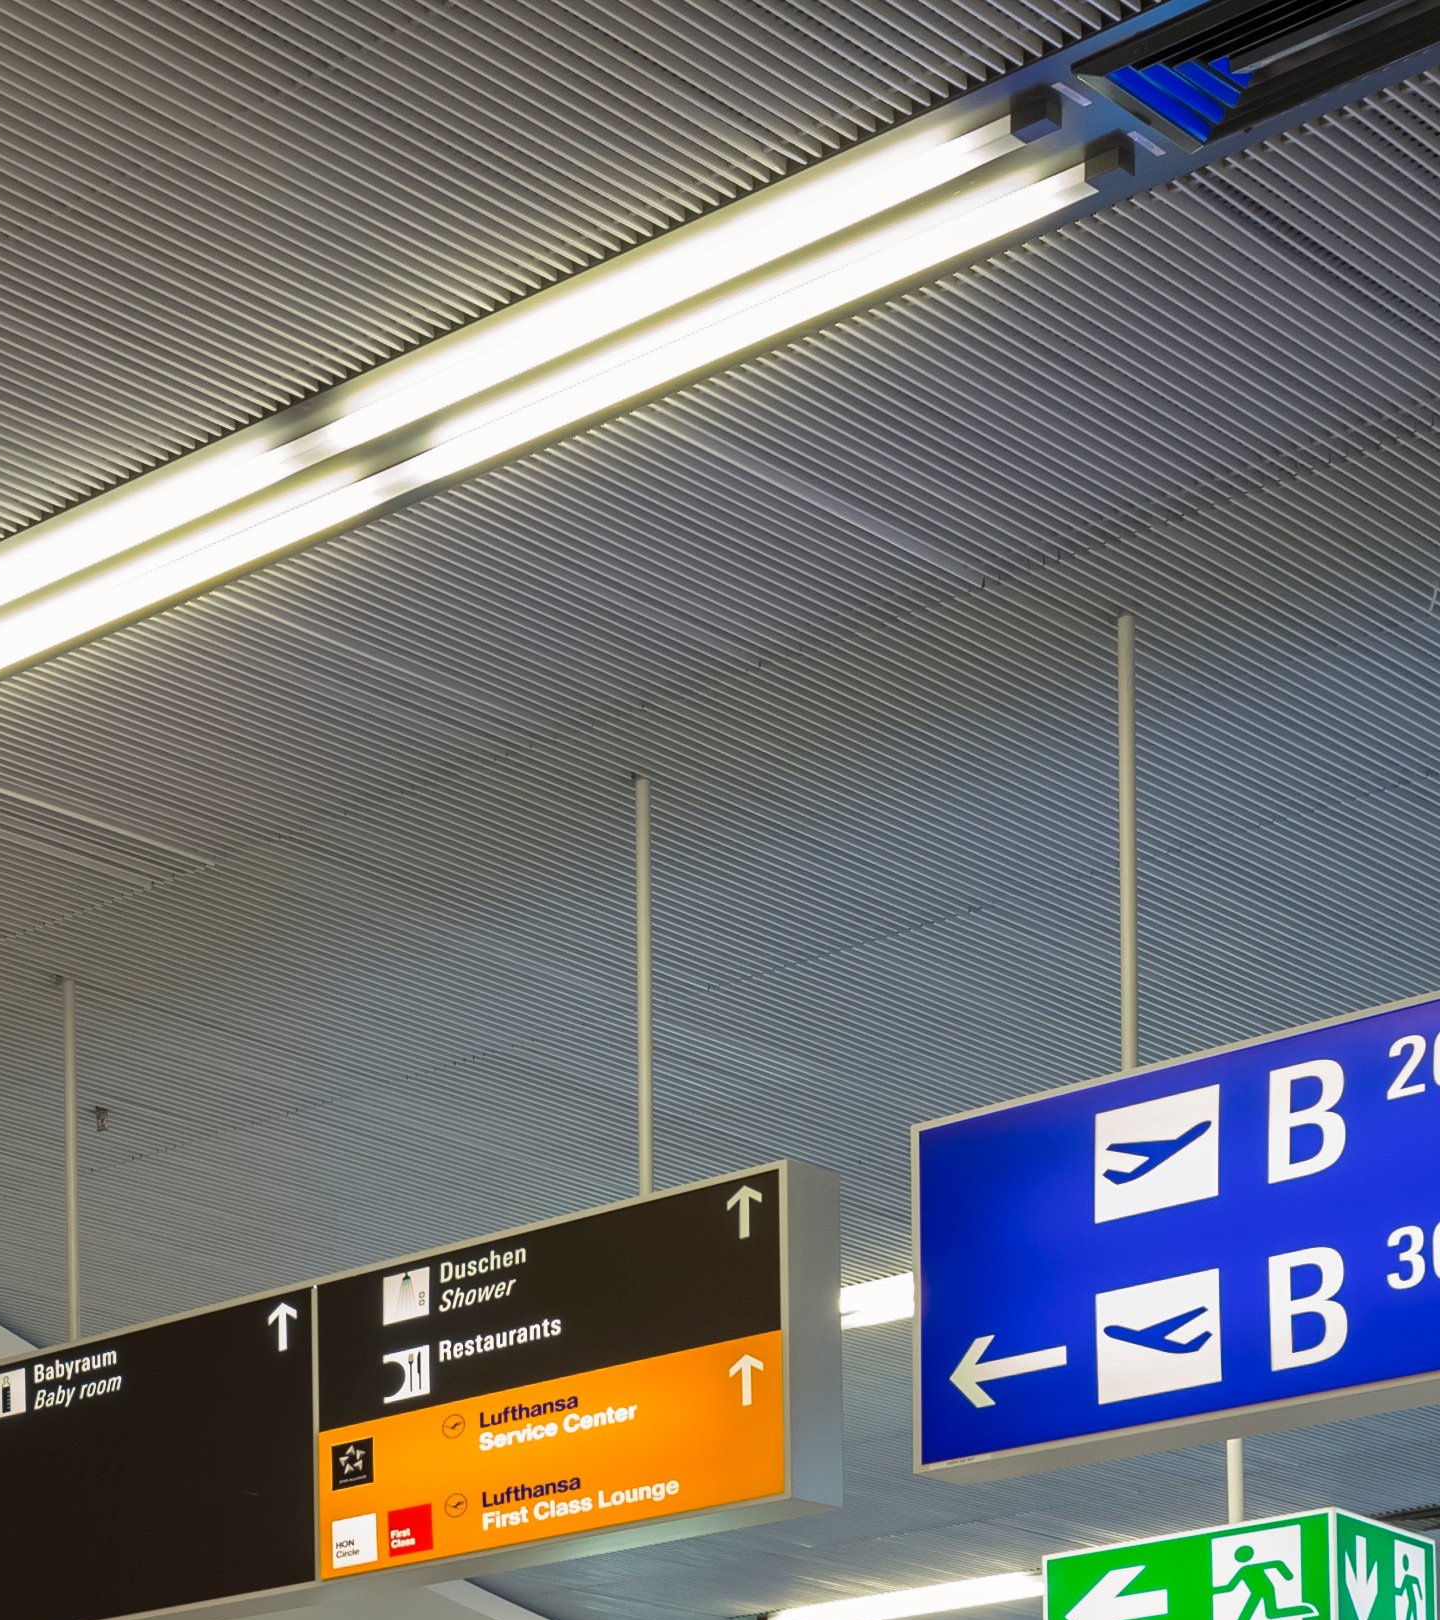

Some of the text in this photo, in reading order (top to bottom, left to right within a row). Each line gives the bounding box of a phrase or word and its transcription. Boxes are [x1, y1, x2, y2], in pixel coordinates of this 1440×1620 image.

[1267, 1034, 1440, 1184] B 2
[440, 1247, 527, 1284] Duschen
[439, 1279, 517, 1313] Shower
[1268, 1221, 1440, 1373] B 3
[439, 1318, 562, 1362] Restaurants
[34, 1350, 117, 1384] Babyraum
[34, 1375, 122, 1410] Baby room
[479, 1405, 637, 1451] Service Center
[480, 1396, 579, 1428] Lufthansa
[482, 1477, 581, 1508] Lufthansa
[482, 1479, 680, 1531] First Class Lounge
[336, 1539, 355, 1549] HON
[390, 1528, 411, 1539] First
[336, 1549, 360, 1558] Circle
